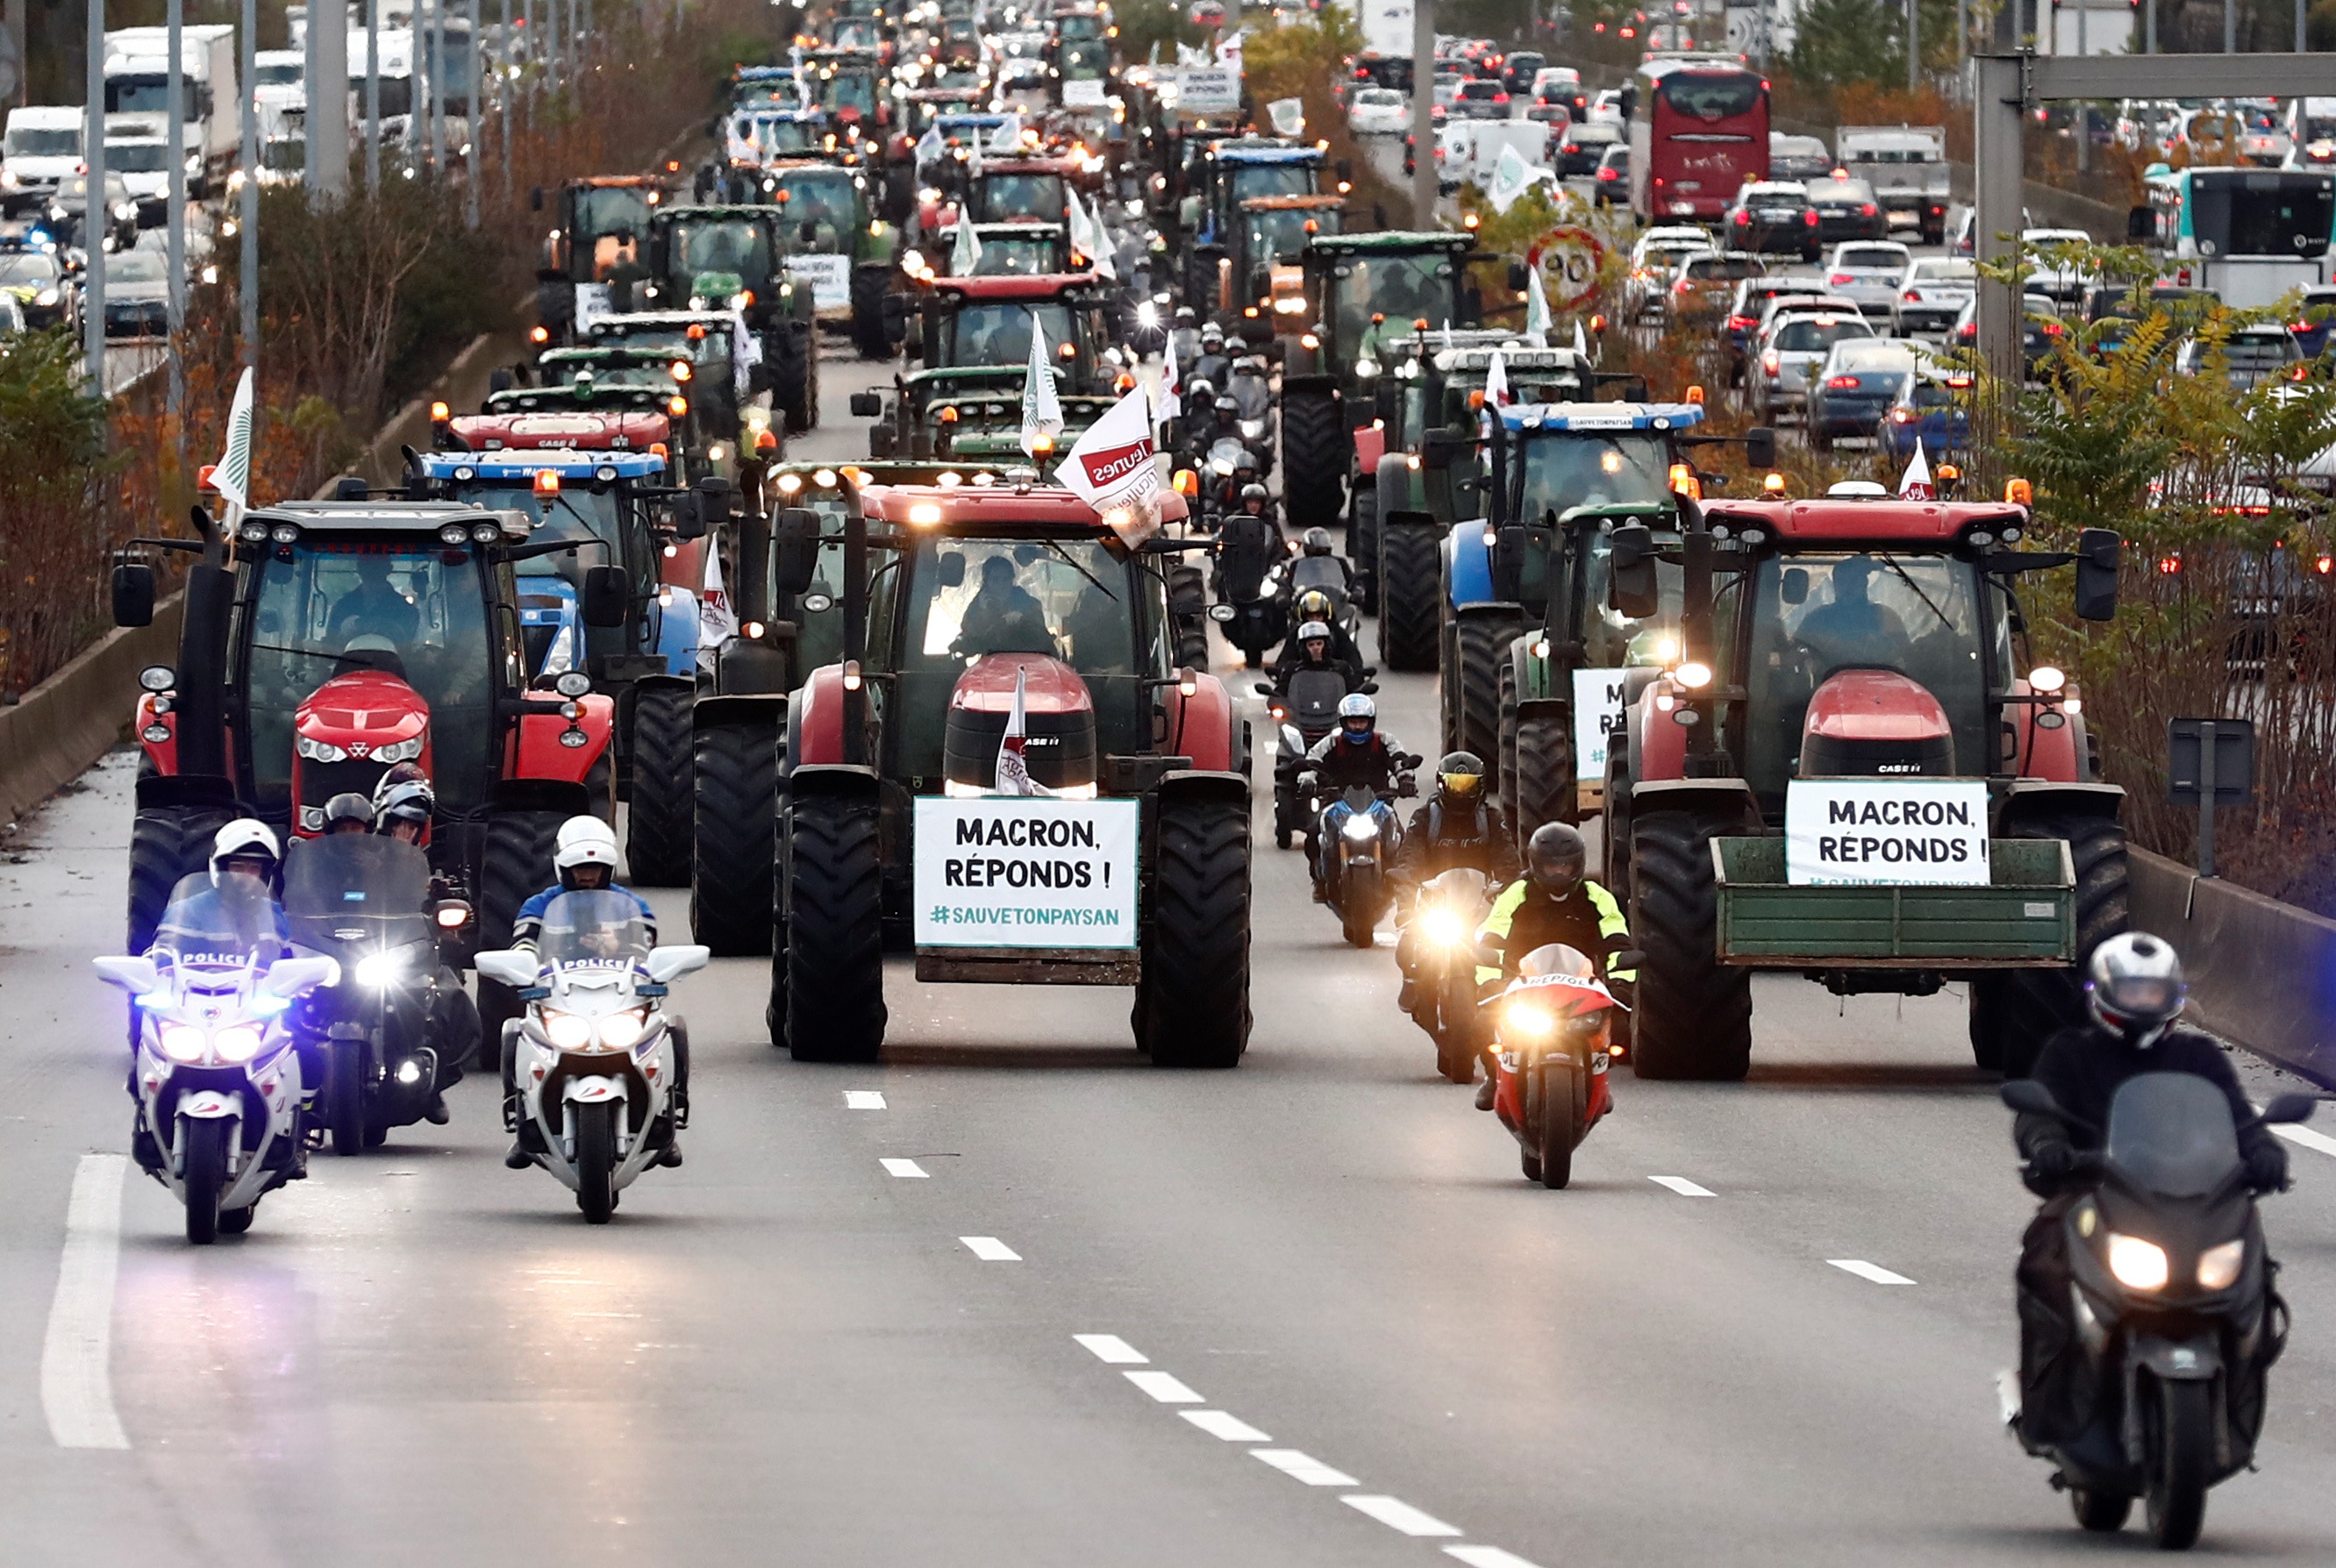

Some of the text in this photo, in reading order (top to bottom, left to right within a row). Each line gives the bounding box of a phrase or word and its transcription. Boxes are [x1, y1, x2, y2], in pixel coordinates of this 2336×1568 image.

[1545, 253, 1588, 283] 90
[1878, 764, 1910, 773] CASE
[1829, 800, 1975, 828] MACRON,
[956, 817, 1101, 851] MACRON,
[1819, 831, 1968, 863] RÉPONDS
[945, 853, 1111, 889] RÉPONDS !
[930, 905, 1119, 926] #SAUVETONPAYSAN
[182, 952, 246, 966] POLICE
[564, 959, 625, 970] POLICE
[1530, 974, 1586, 987] REPSOL
